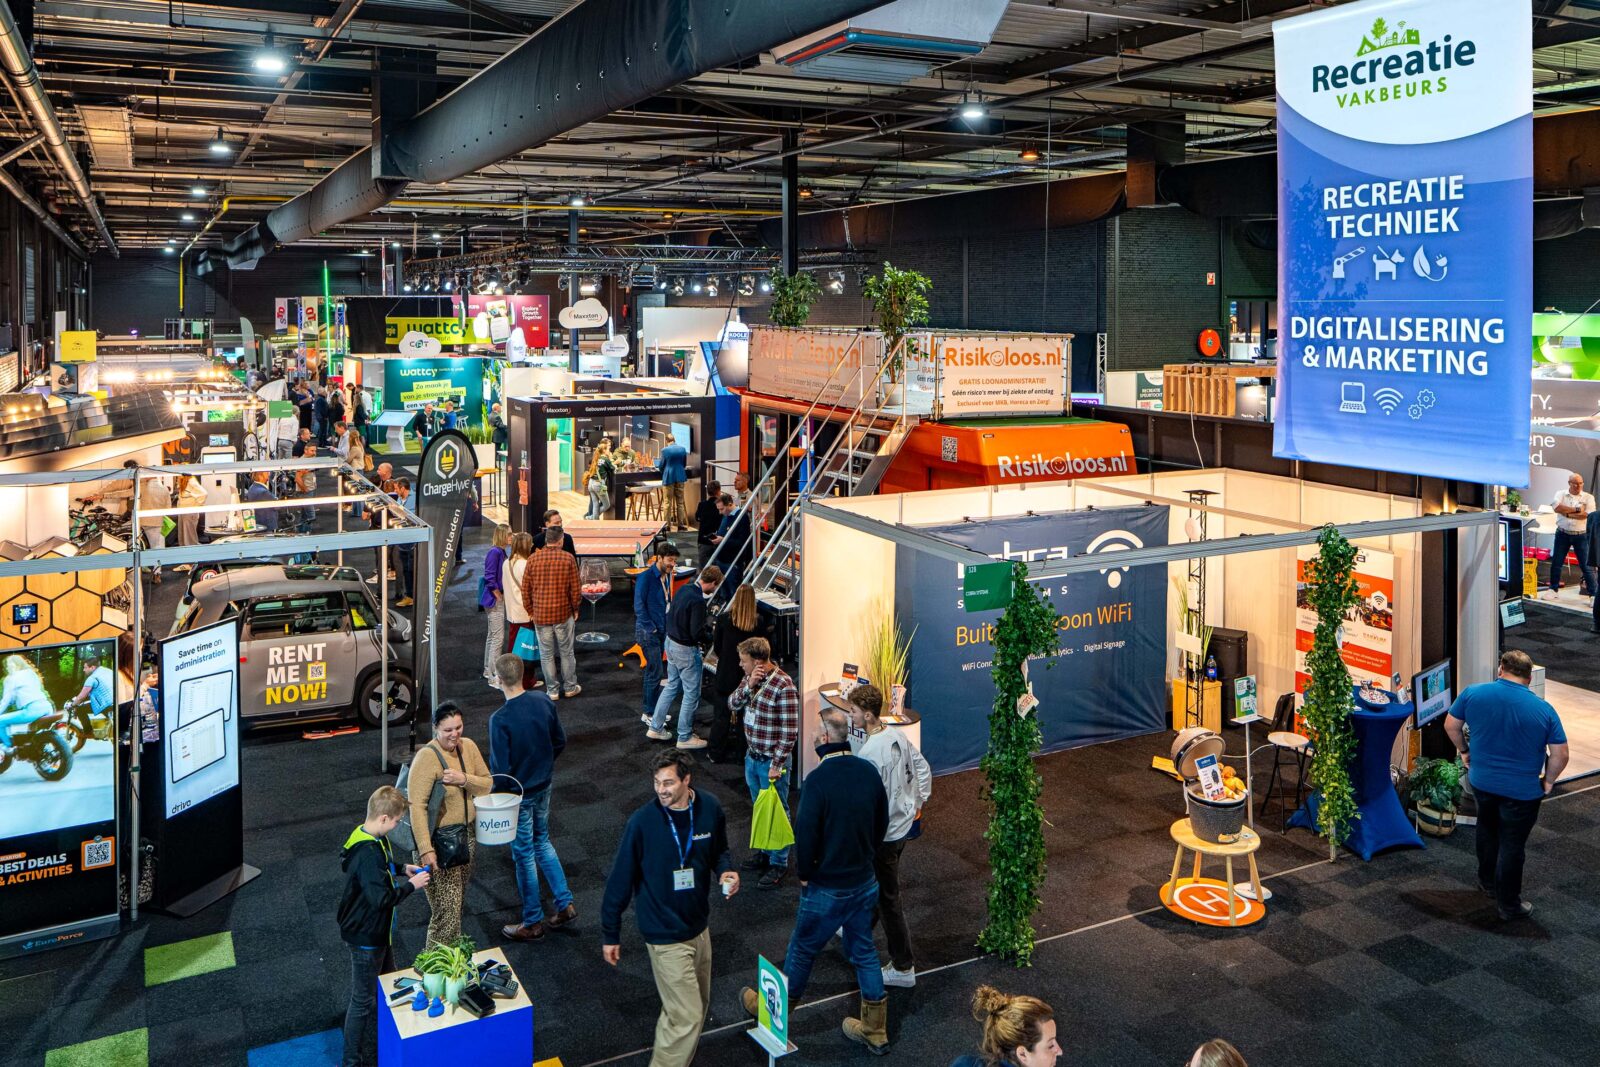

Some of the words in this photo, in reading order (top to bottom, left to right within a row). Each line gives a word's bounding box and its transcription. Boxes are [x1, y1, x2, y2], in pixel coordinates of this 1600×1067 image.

[1312, 34, 1476, 93] Recreatie
[1336, 77, 1448, 108] VAKBEURS
[1323, 175, 1464, 210] RECREATIE
[1327, 207, 1459, 239] TECHNIEK
[1291, 316, 1505, 344] DIGITALISERING
[1302, 345, 1320, 368] &
[1325, 345, 1488, 376] MARKETING
[400, 367, 438, 378] wattcy
[959, 378, 981, 386] GRATIS
[981, 377, 1047, 386] LOONADMINISTRATIE!
[957, 398, 981, 407] Exclusief
[967, 388, 987, 396] risico's
[1002, 388, 1010, 397] bij
[1010, 387, 1027, 396] ziekte
[1028, 387, 1034, 395] of
[1034, 387, 1054, 396] ontslag
[423, 479, 470, 497] ChargeHyve
[444, 508, 461, 558] opladen
[1097, 602, 1133, 625] WiFi
[175, 648, 226, 672] administration
[178, 648, 196, 659] Save
[196, 641, 213, 653] time
[213, 638, 223, 647] on
[268, 642, 327, 666] RENT
[961, 661, 976, 672] WiFi
[1084, 642, 1103, 653] Digital
[1103, 639, 1127, 651] Signage
[266, 664, 300, 686] ME
[265, 681, 327, 706] NOW!
[479, 818, 510, 832] xylem
[0, 860, 27, 875] BEST
[27, 852, 67, 870] DEALS
[7, 863, 73, 885] ACTIVITIES
